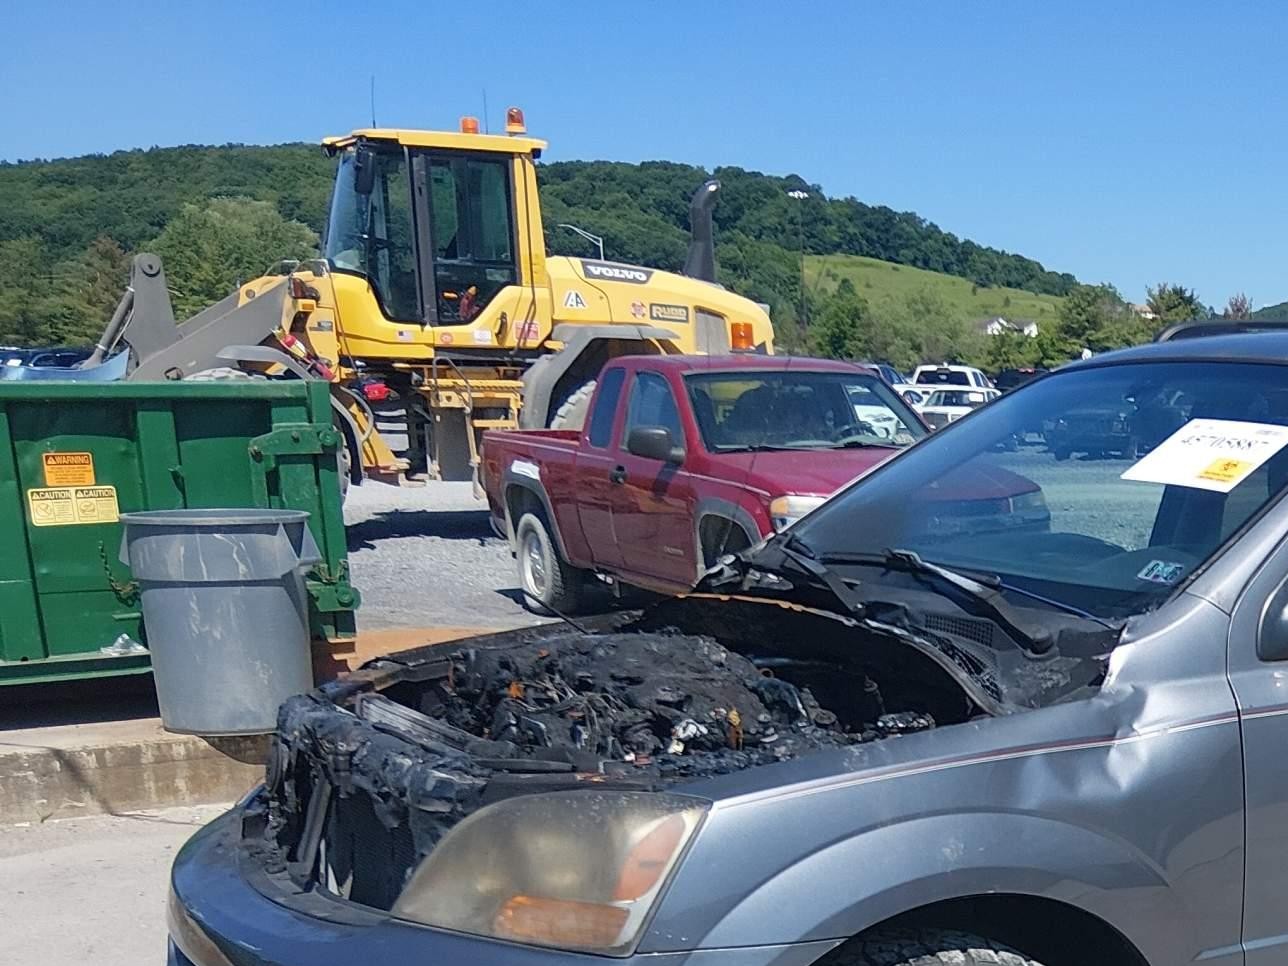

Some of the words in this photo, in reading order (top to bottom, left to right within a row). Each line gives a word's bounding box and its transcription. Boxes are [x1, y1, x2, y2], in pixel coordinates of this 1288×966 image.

[586, 265, 647, 281] VOLVO
[55, 455, 90, 465] WARNING
[39, 490, 72, 499] CAUTION
[83, 489, 114, 498] CAUTION
